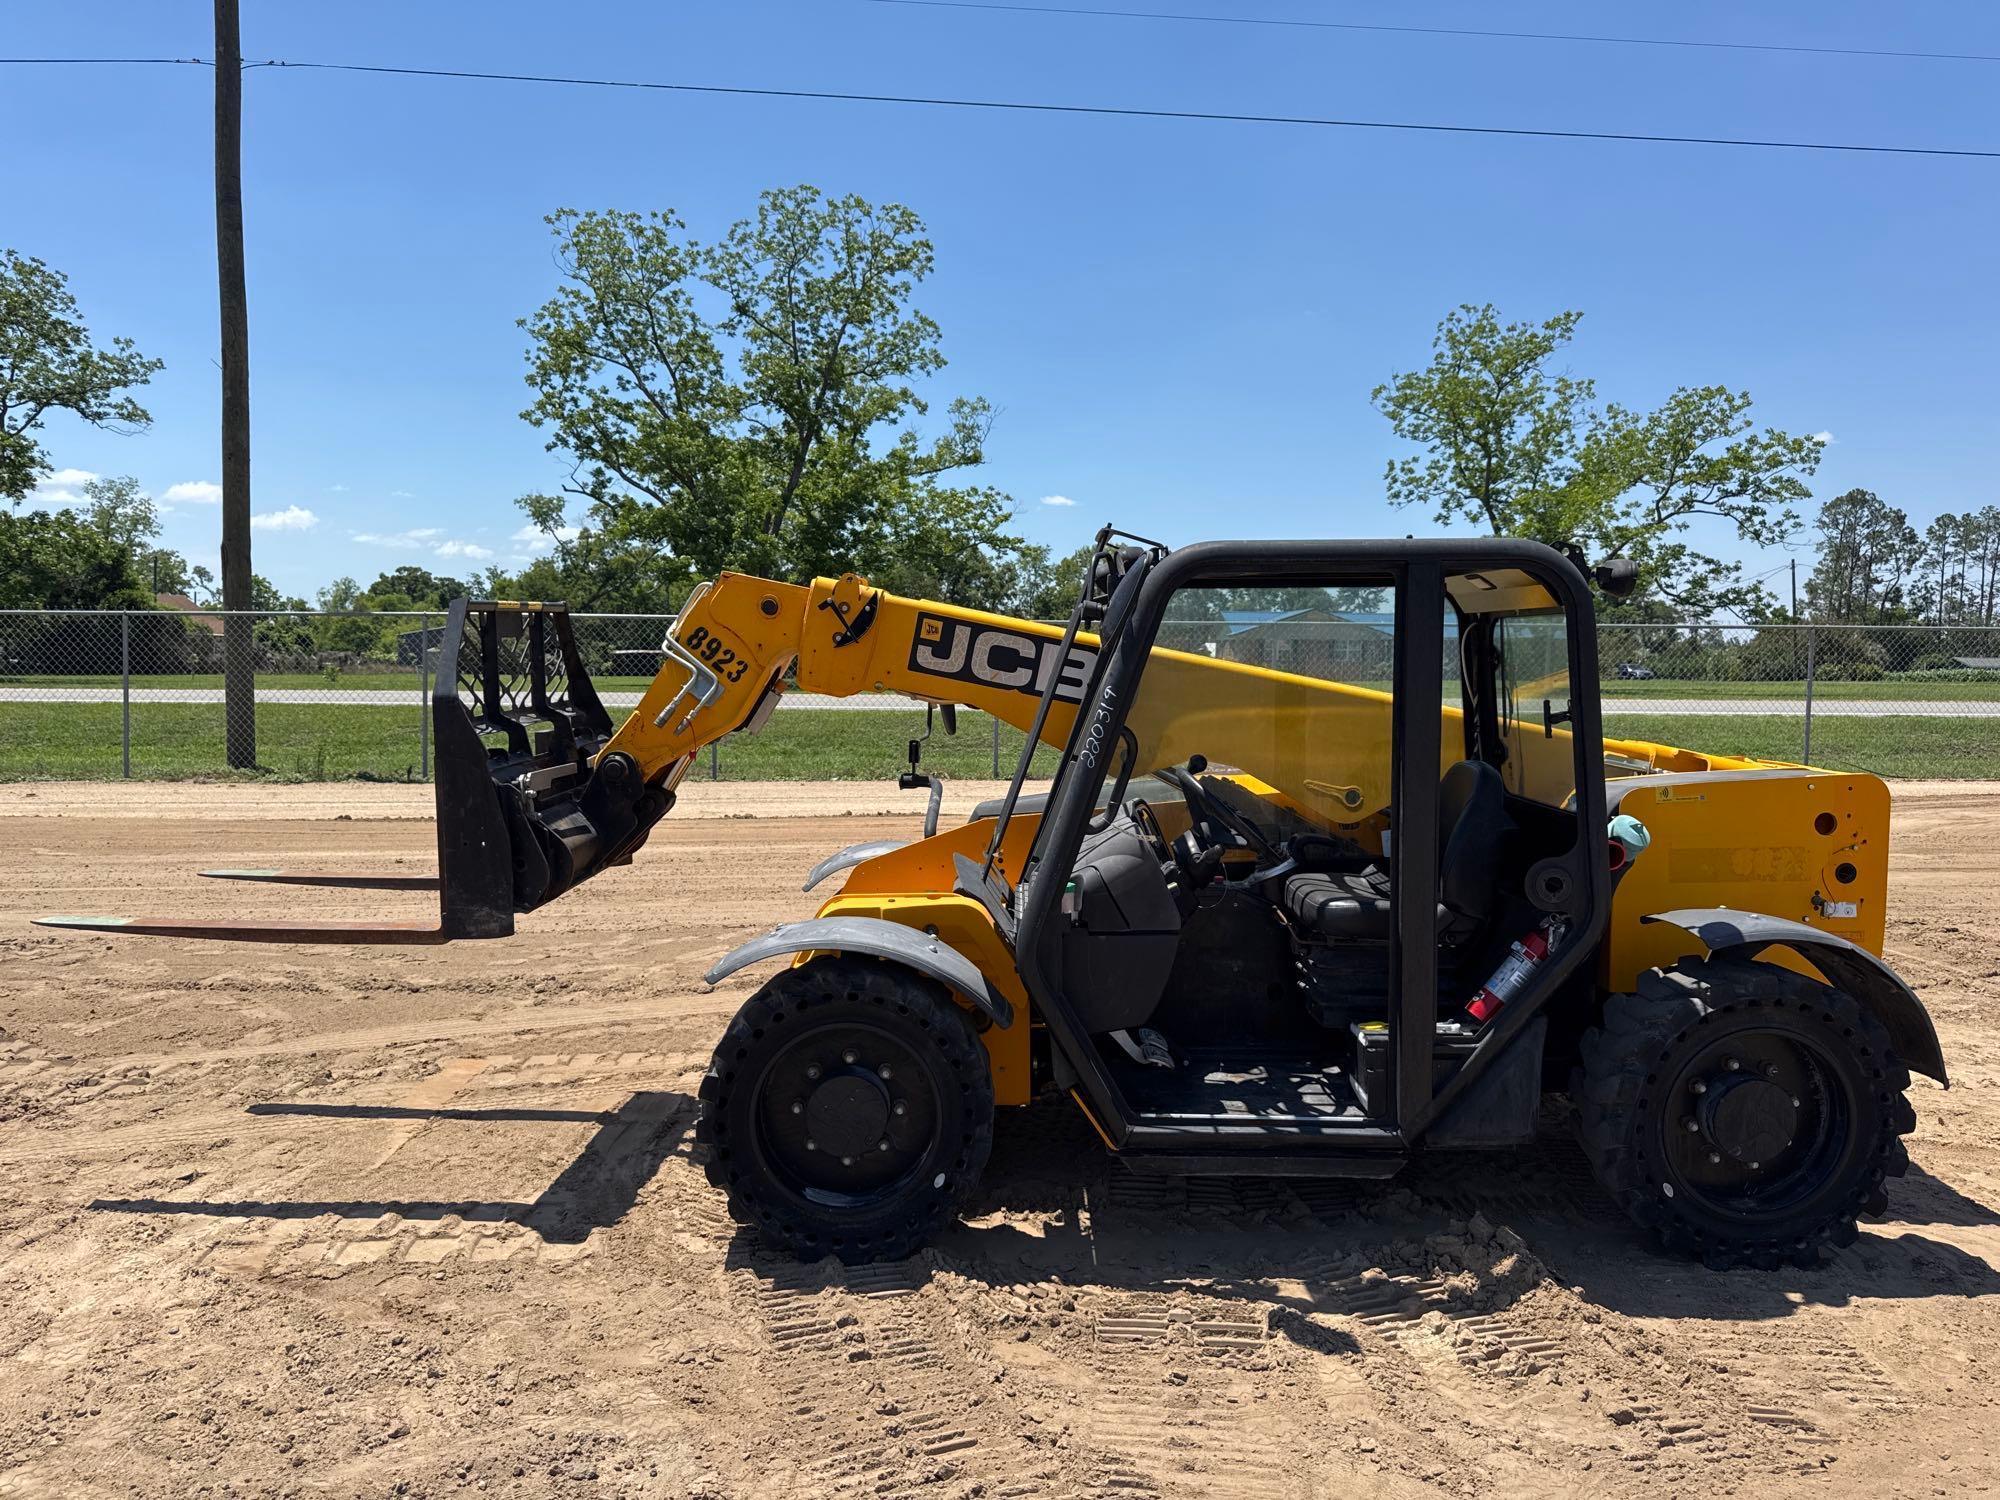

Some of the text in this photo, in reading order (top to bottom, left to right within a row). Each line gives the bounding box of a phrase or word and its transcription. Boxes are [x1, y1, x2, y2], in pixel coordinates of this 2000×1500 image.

[687, 626, 749, 683] 8923
[916, 624, 1100, 700] JCB
[1080, 685, 1117, 769] 220319
